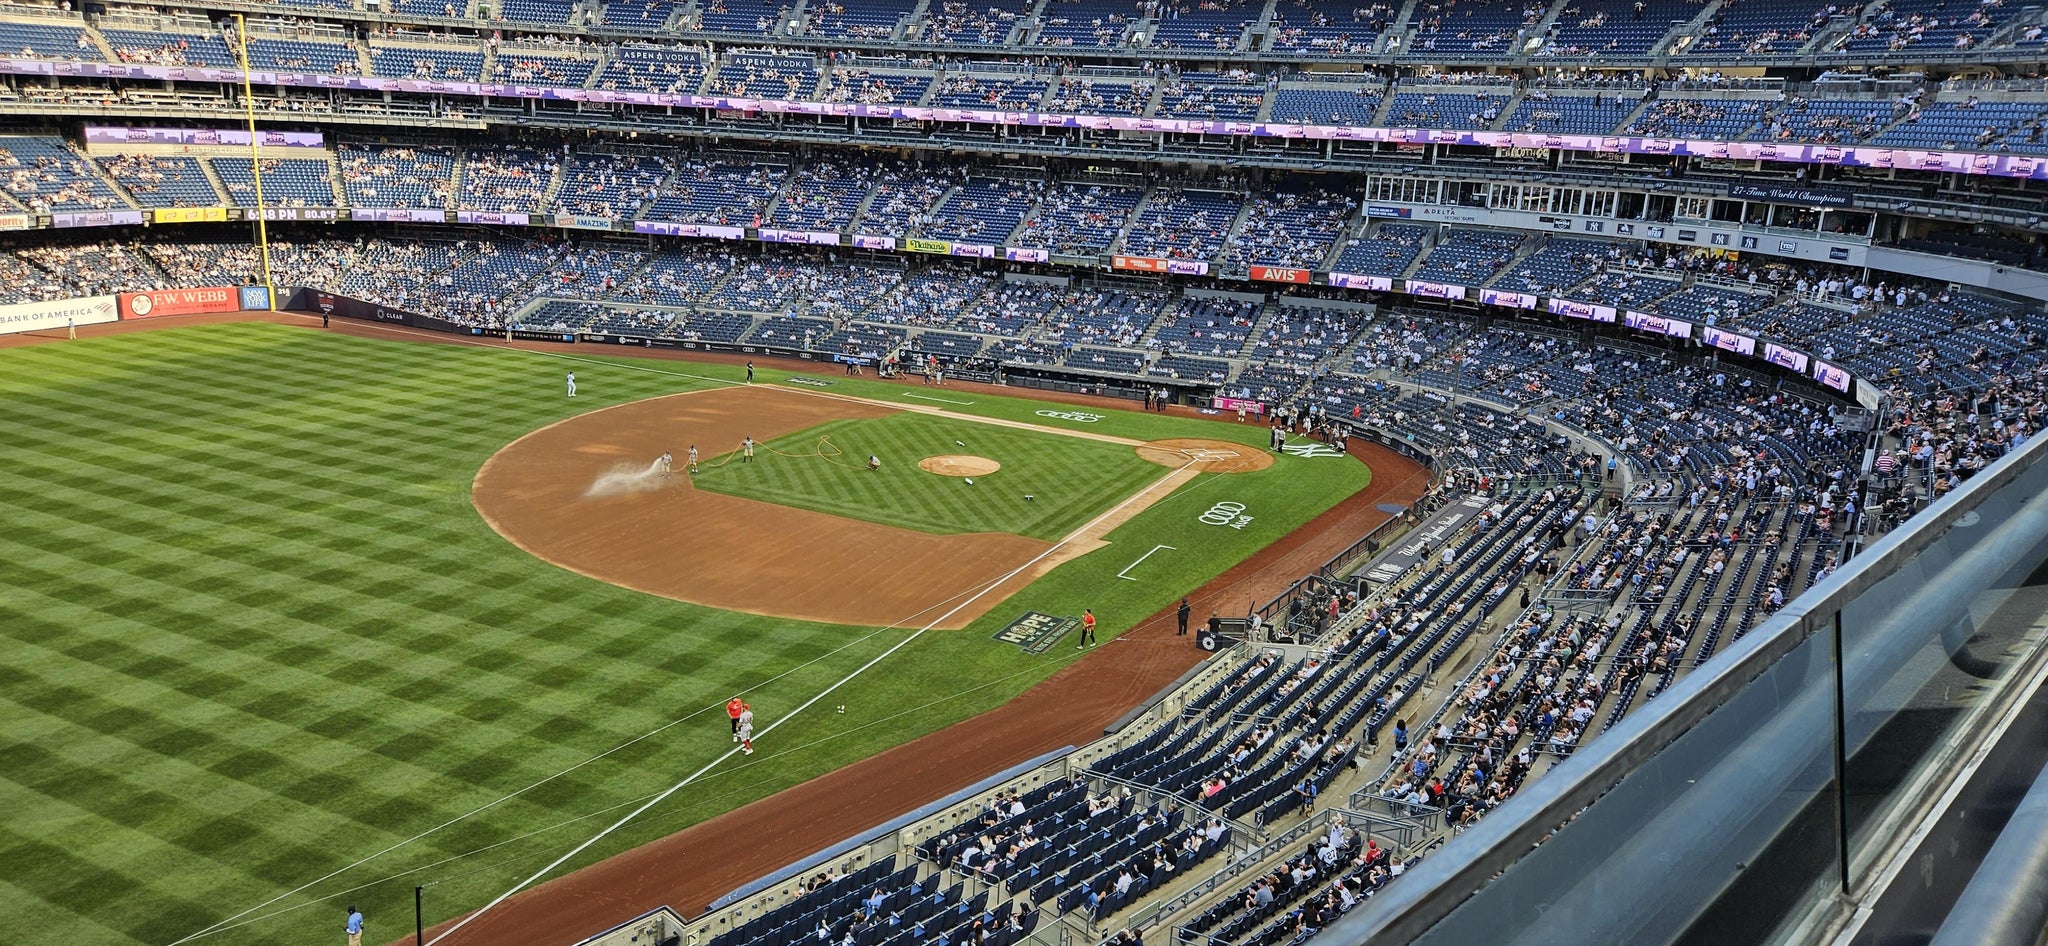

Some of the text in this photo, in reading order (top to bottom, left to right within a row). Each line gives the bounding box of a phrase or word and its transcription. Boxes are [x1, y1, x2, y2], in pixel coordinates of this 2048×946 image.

[624, 51, 696, 61] ASPEN VODKA
[735, 57, 808, 68] ASPEN VODKA
[1732, 185, 1846, 204] 27-Time World Champions
[279, 209, 297, 220] PM
[305, 210, 336, 219] 80.8°F
[0, 217, 24, 226] ority
[577, 219, 609, 227] AMAZING
[910, 240, 947, 251] Nathan's
[1263, 268, 1295, 281] AVIS
[153, 289, 227, 306] F.W. WEBB
[245, 294, 266, 302] YORK
[247, 299, 265, 307] LIFE
[0, 308, 93, 324] BANK OF AMERICA
[386, 312, 403, 320] CLEAR
[1230, 515, 1254, 530] Audi
[1000, 613, 1052, 643] HOPE
[1326, 849, 1335, 860] 27
